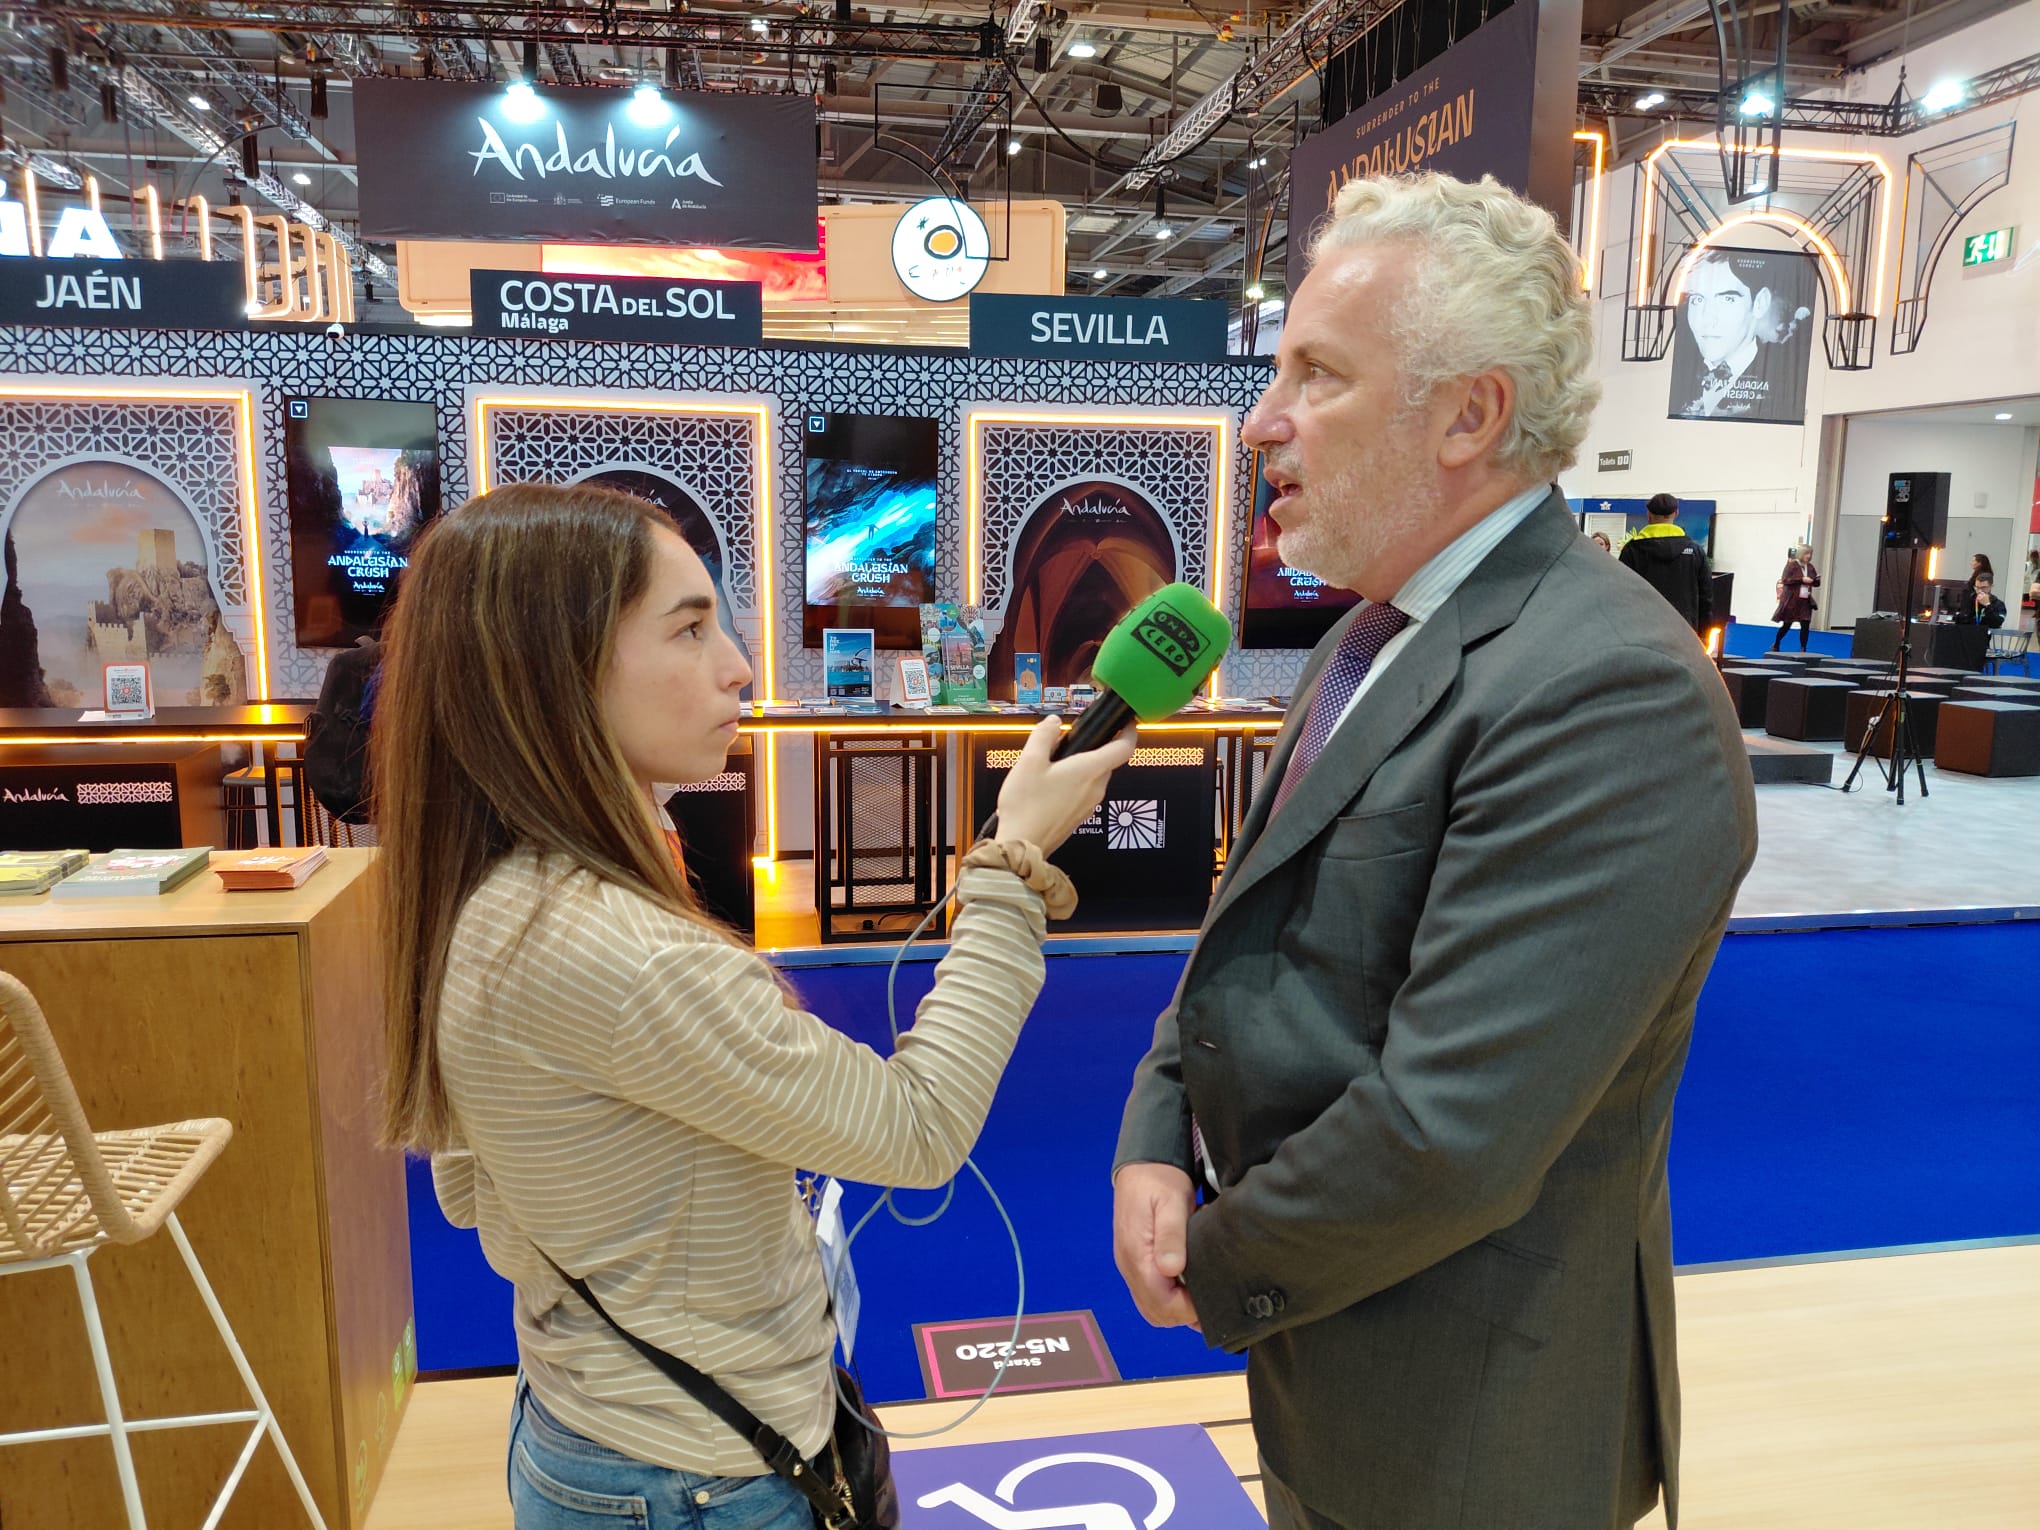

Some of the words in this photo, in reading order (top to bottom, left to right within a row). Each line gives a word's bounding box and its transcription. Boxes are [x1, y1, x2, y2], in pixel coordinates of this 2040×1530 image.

[1355, 100, 1404, 139] SURRENDER
[1408, 91, 1419, 107] TO
[1423, 77, 1440, 97] THE
[467, 116, 724, 188] Andalucía
[36, 269, 142, 310] JAÉN
[500, 280, 619, 315] COSTA
[622, 297, 663, 317] DEL
[665, 287, 736, 320] SOL
[501, 312, 569, 334] Málaga
[1031, 311, 1169, 345] SEVILLA
[57, 479, 145, 500] Andalucía
[1060, 497, 1131, 516] Andalucía
[347, 566, 390, 578] CRUSH
[851, 573, 891, 584] CRUSH
[1155, 611, 1197, 649] ONDA
[1146, 628, 1185, 663] CERO
[3, 787, 70, 804] Andalucía
[1078, 827, 1104, 835] SEVILLA
[955, 1336, 1071, 1361] N5-220
